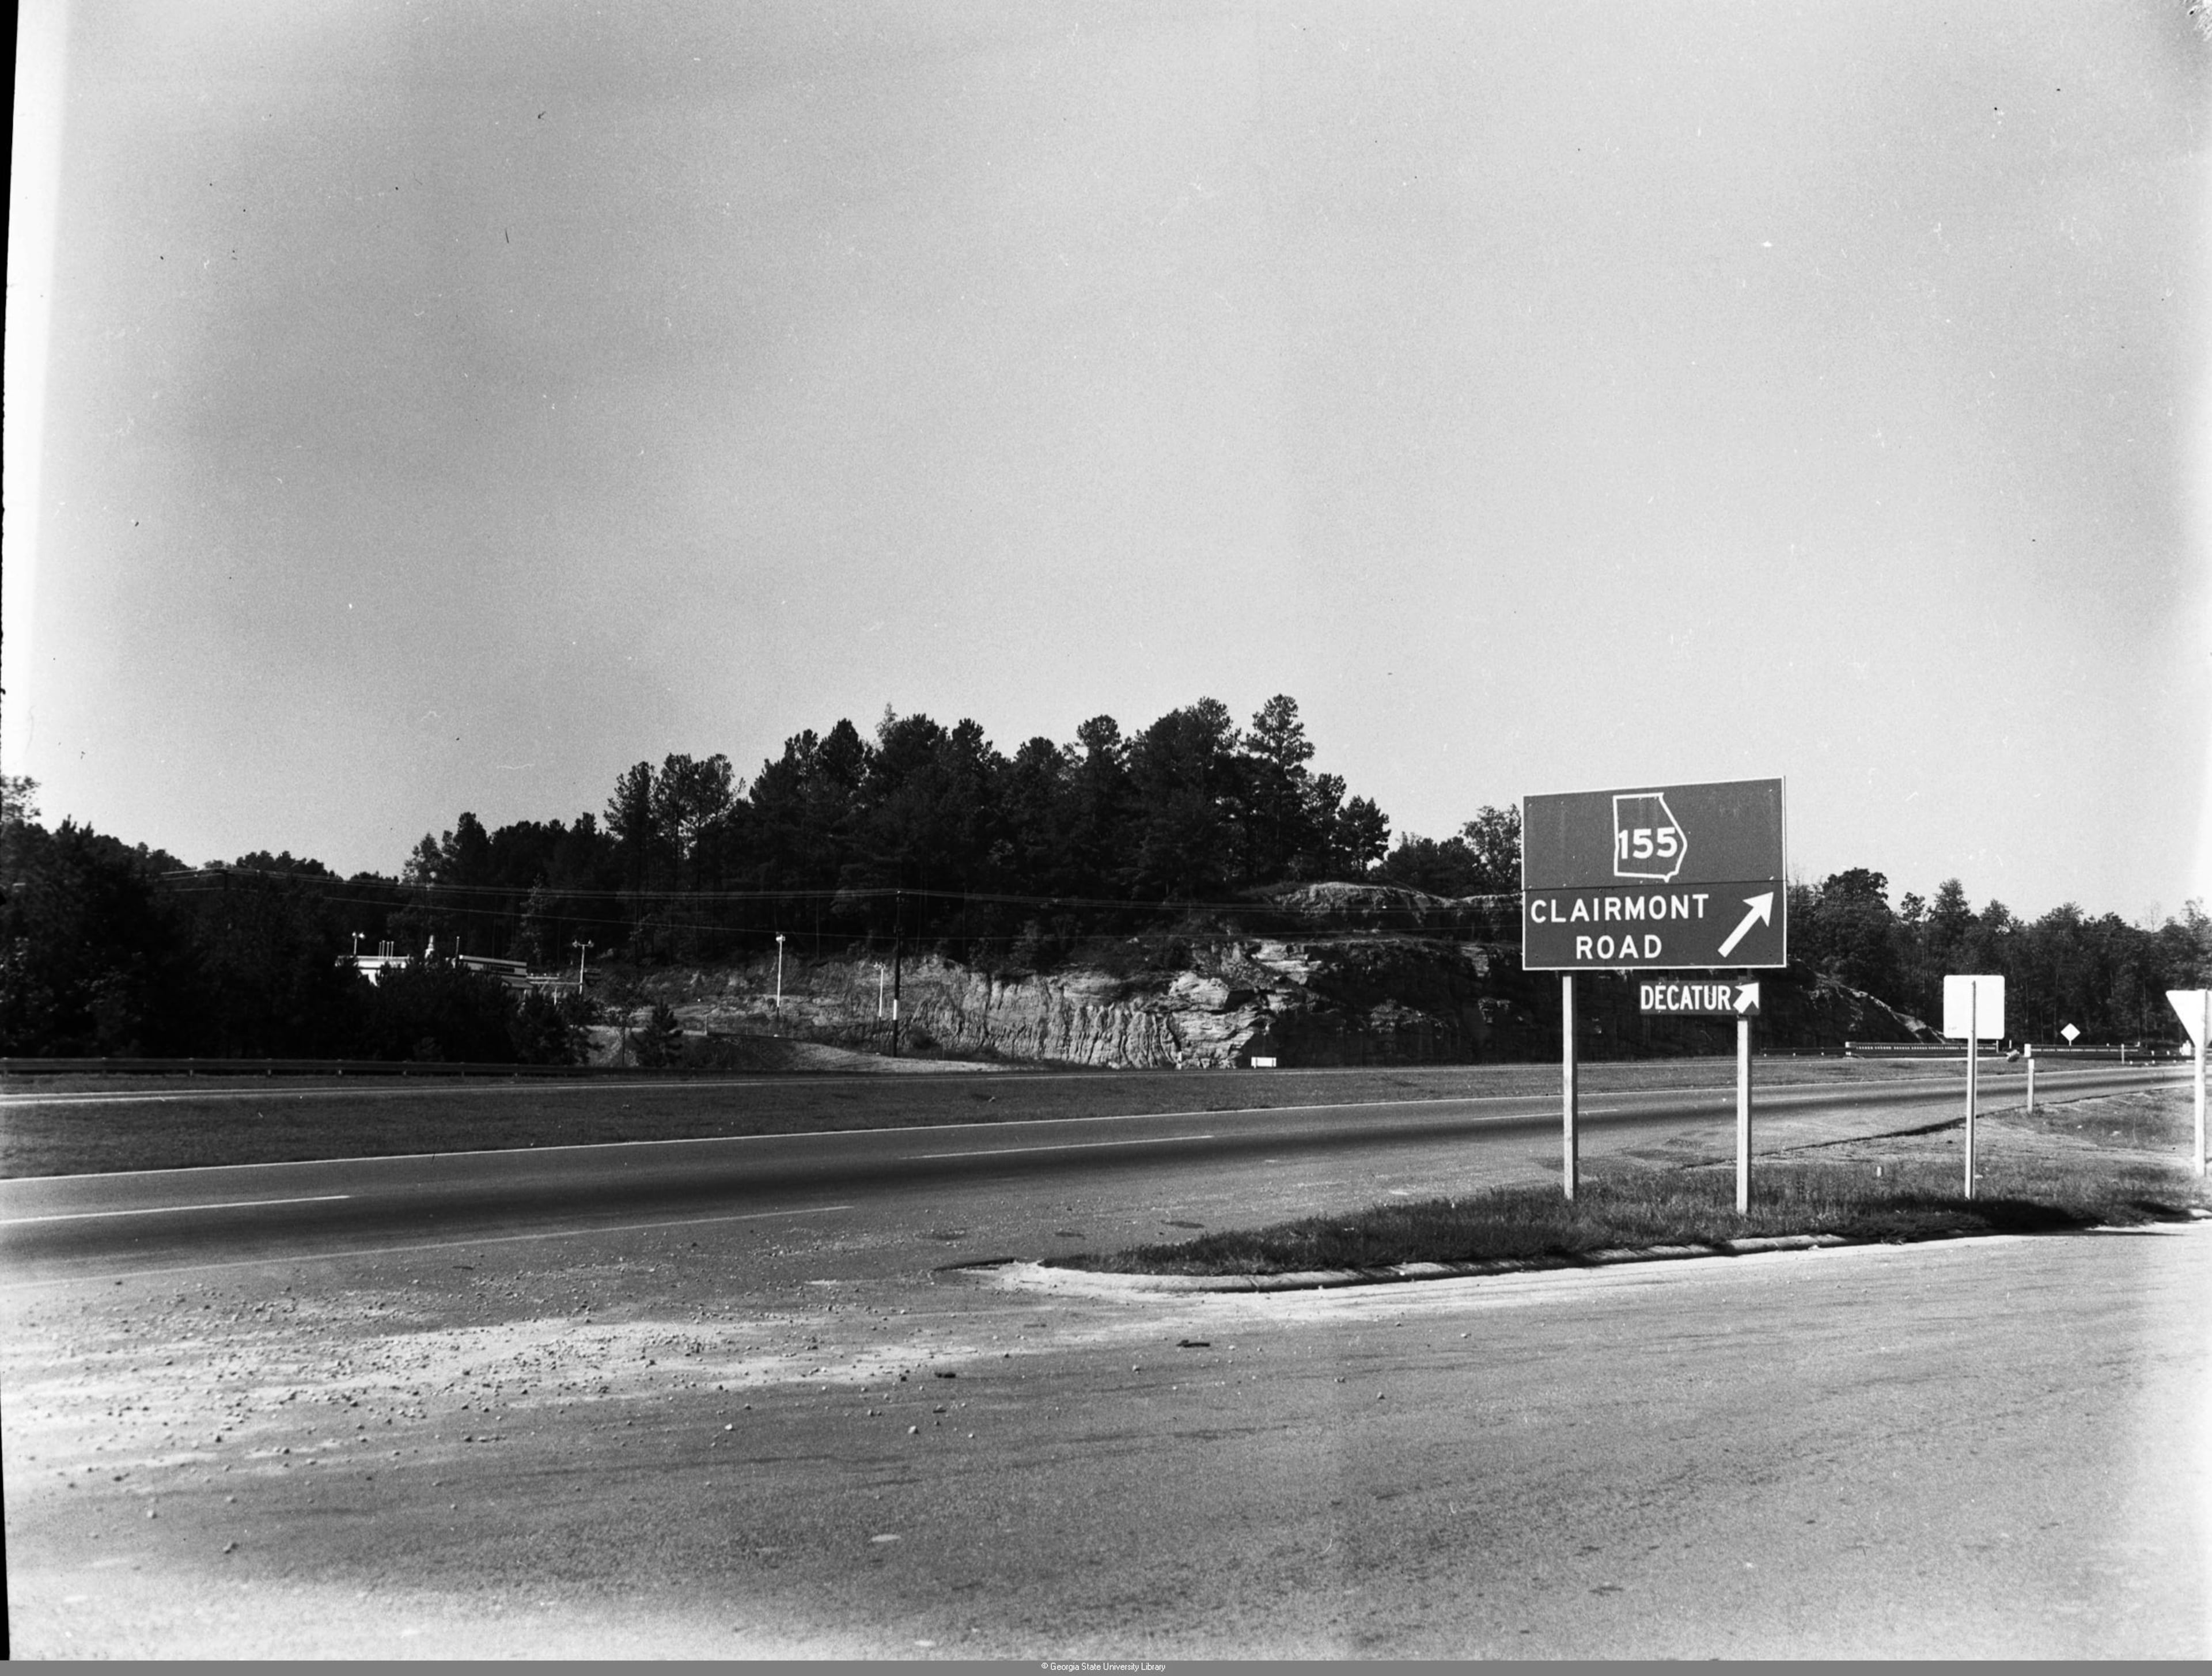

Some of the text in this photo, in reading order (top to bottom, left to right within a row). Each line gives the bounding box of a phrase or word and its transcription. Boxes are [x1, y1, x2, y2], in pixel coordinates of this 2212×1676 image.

[1618, 827, 1678, 859] 155
[1531, 894, 1709, 923] CLAIRMONT
[1576, 934, 1662, 960] ROAD
[1641, 985, 1731, 1010] DECATUR
